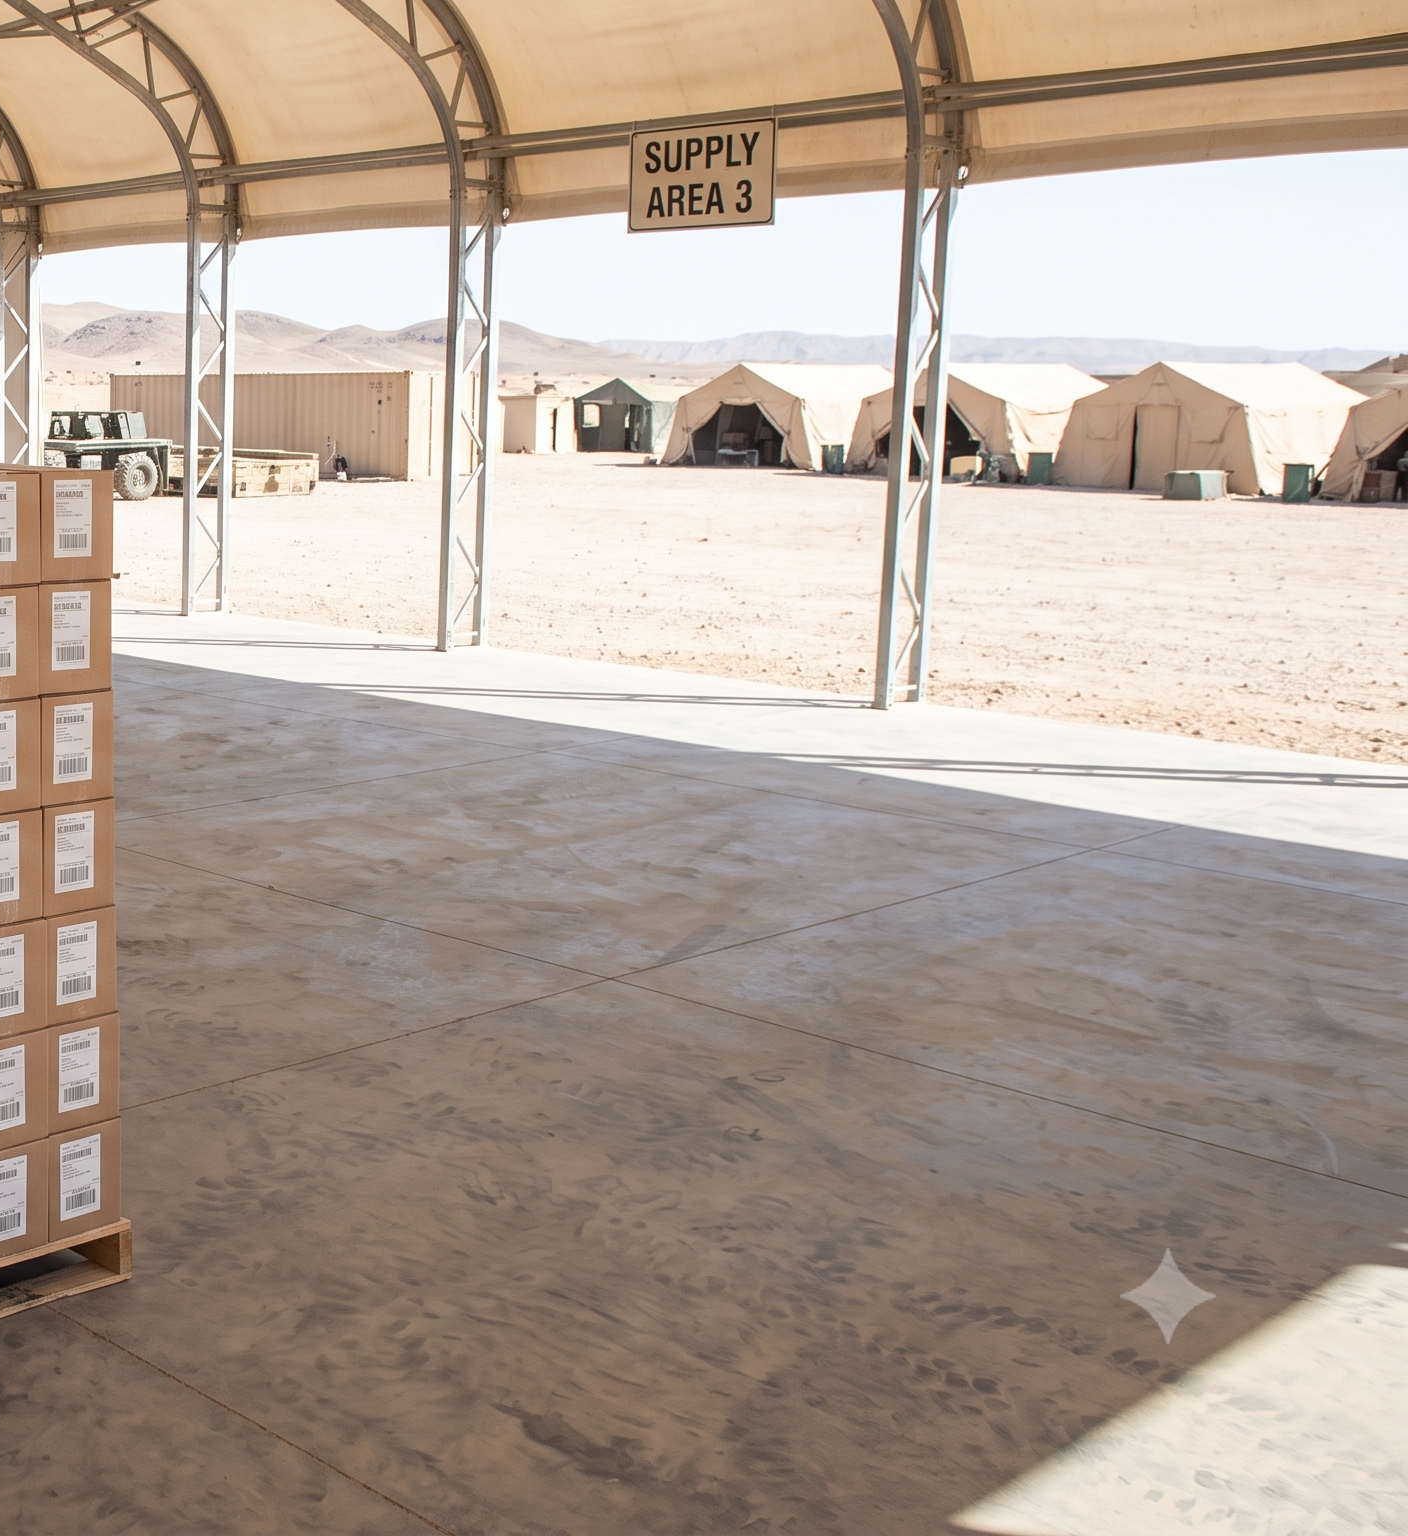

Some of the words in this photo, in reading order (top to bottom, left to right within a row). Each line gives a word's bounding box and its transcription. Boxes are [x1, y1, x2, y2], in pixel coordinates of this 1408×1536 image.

[645, 131, 760, 174] SUPPLY
[646, 182, 725, 219] AREA
[735, 179, 753, 213] 3
